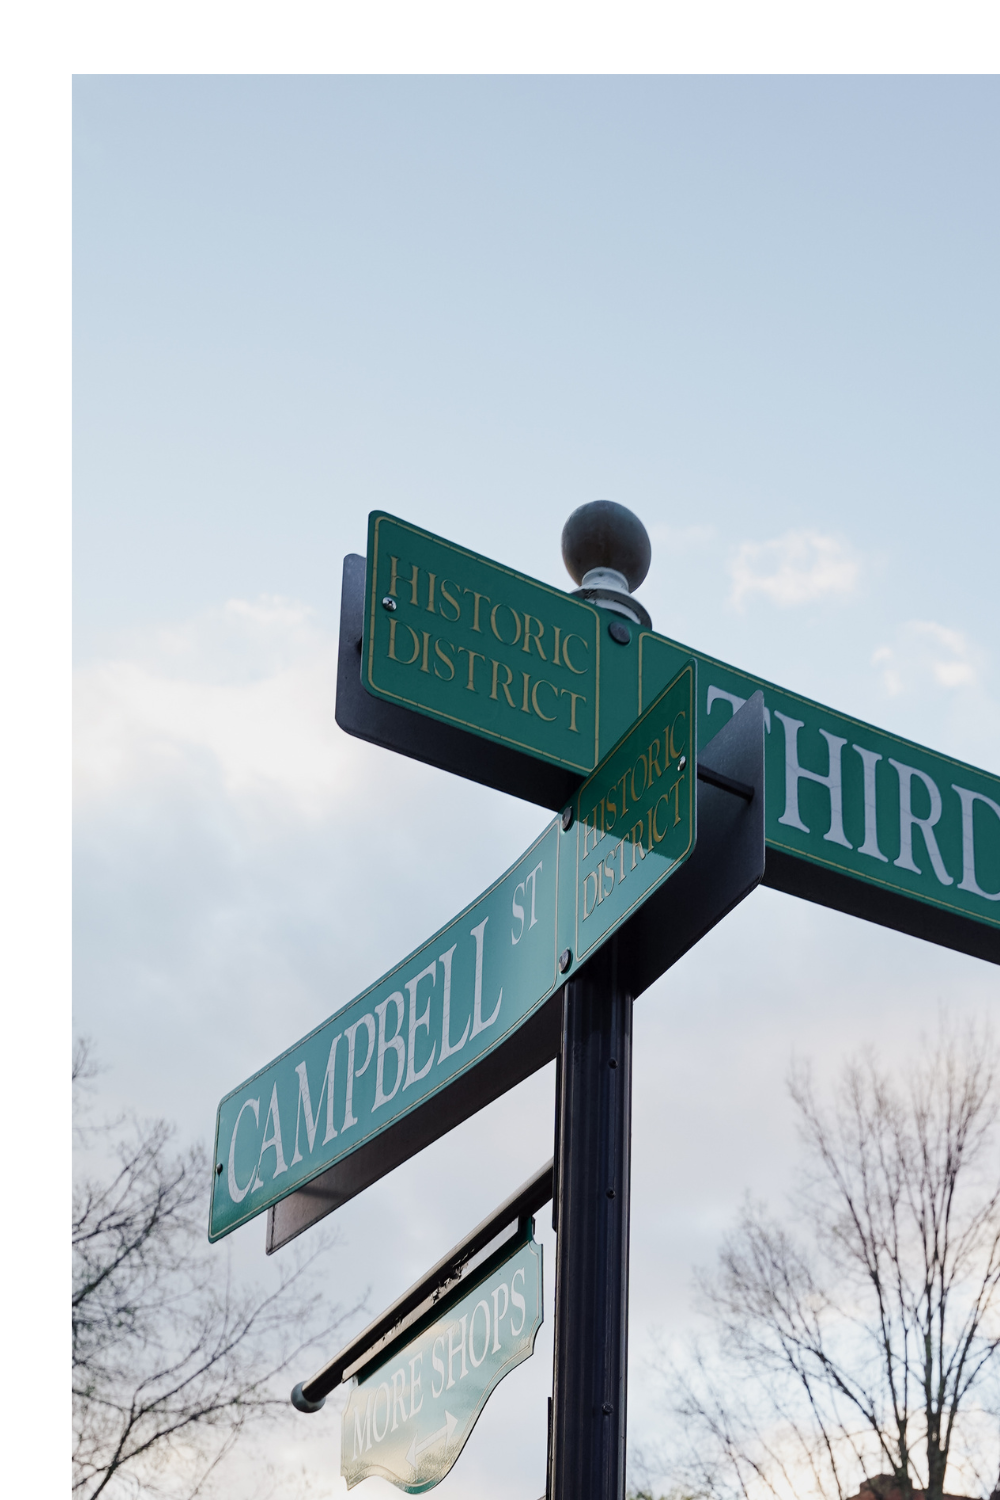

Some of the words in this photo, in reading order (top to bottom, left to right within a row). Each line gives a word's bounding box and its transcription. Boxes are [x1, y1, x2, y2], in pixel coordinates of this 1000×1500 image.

[387, 617, 588, 733] DISTRICT
[388, 555, 589, 675] HISTORIC
[582, 711, 686, 860] HISTORIC
[582, 774, 685, 912] DISTRICT
[227, 915, 504, 1203] CAMPBELL
[511, 861, 544, 946] ST
[351, 1351, 425, 1462] MORE
[431, 1267, 527, 1398] SHOPS
